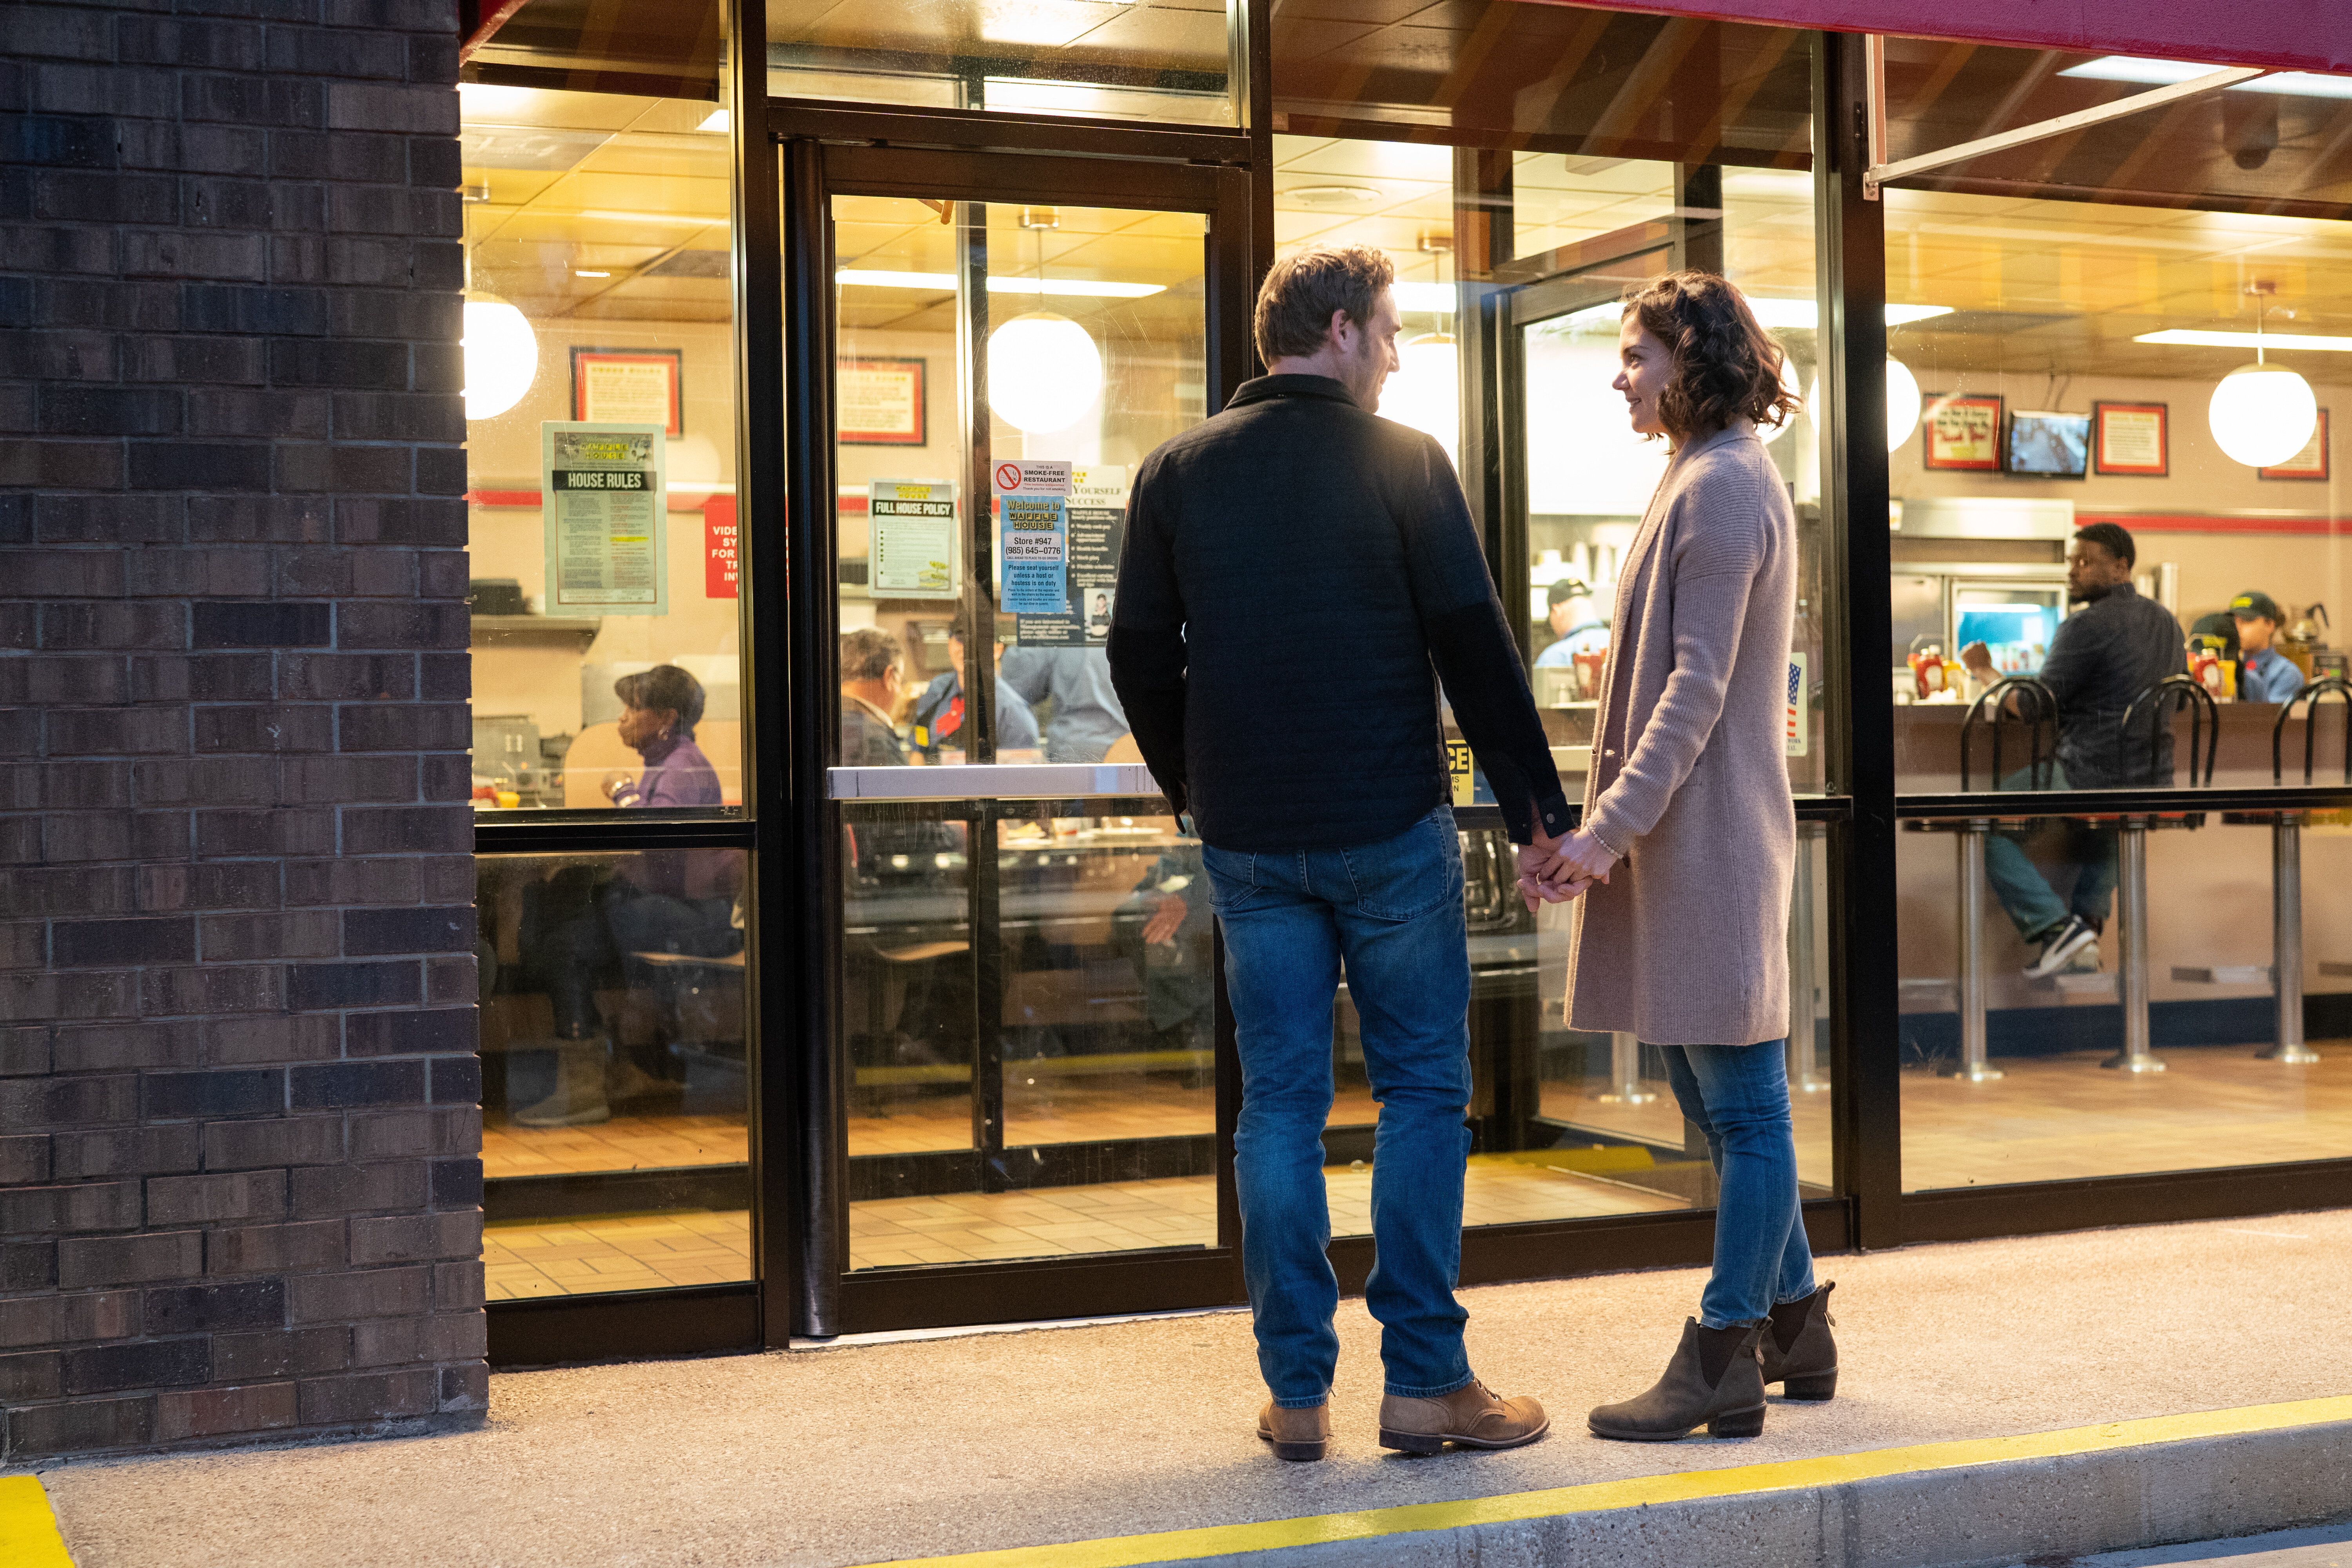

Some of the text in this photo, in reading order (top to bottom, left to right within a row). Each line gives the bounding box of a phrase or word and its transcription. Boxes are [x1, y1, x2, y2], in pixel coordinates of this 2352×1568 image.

[568, 473, 641, 488] HOUSE RULES
[1007, 500, 1061, 510] Welcome to
[1065, 496, 1106, 505] SUCCESS
[876, 502, 951, 515] FULL HOUSE POLICY
[713, 526, 737, 535] VIDE
[711, 549, 735, 559] FOR
[1006, 546, 1024, 555] (985)
[1447, 748, 1468, 770] CE
